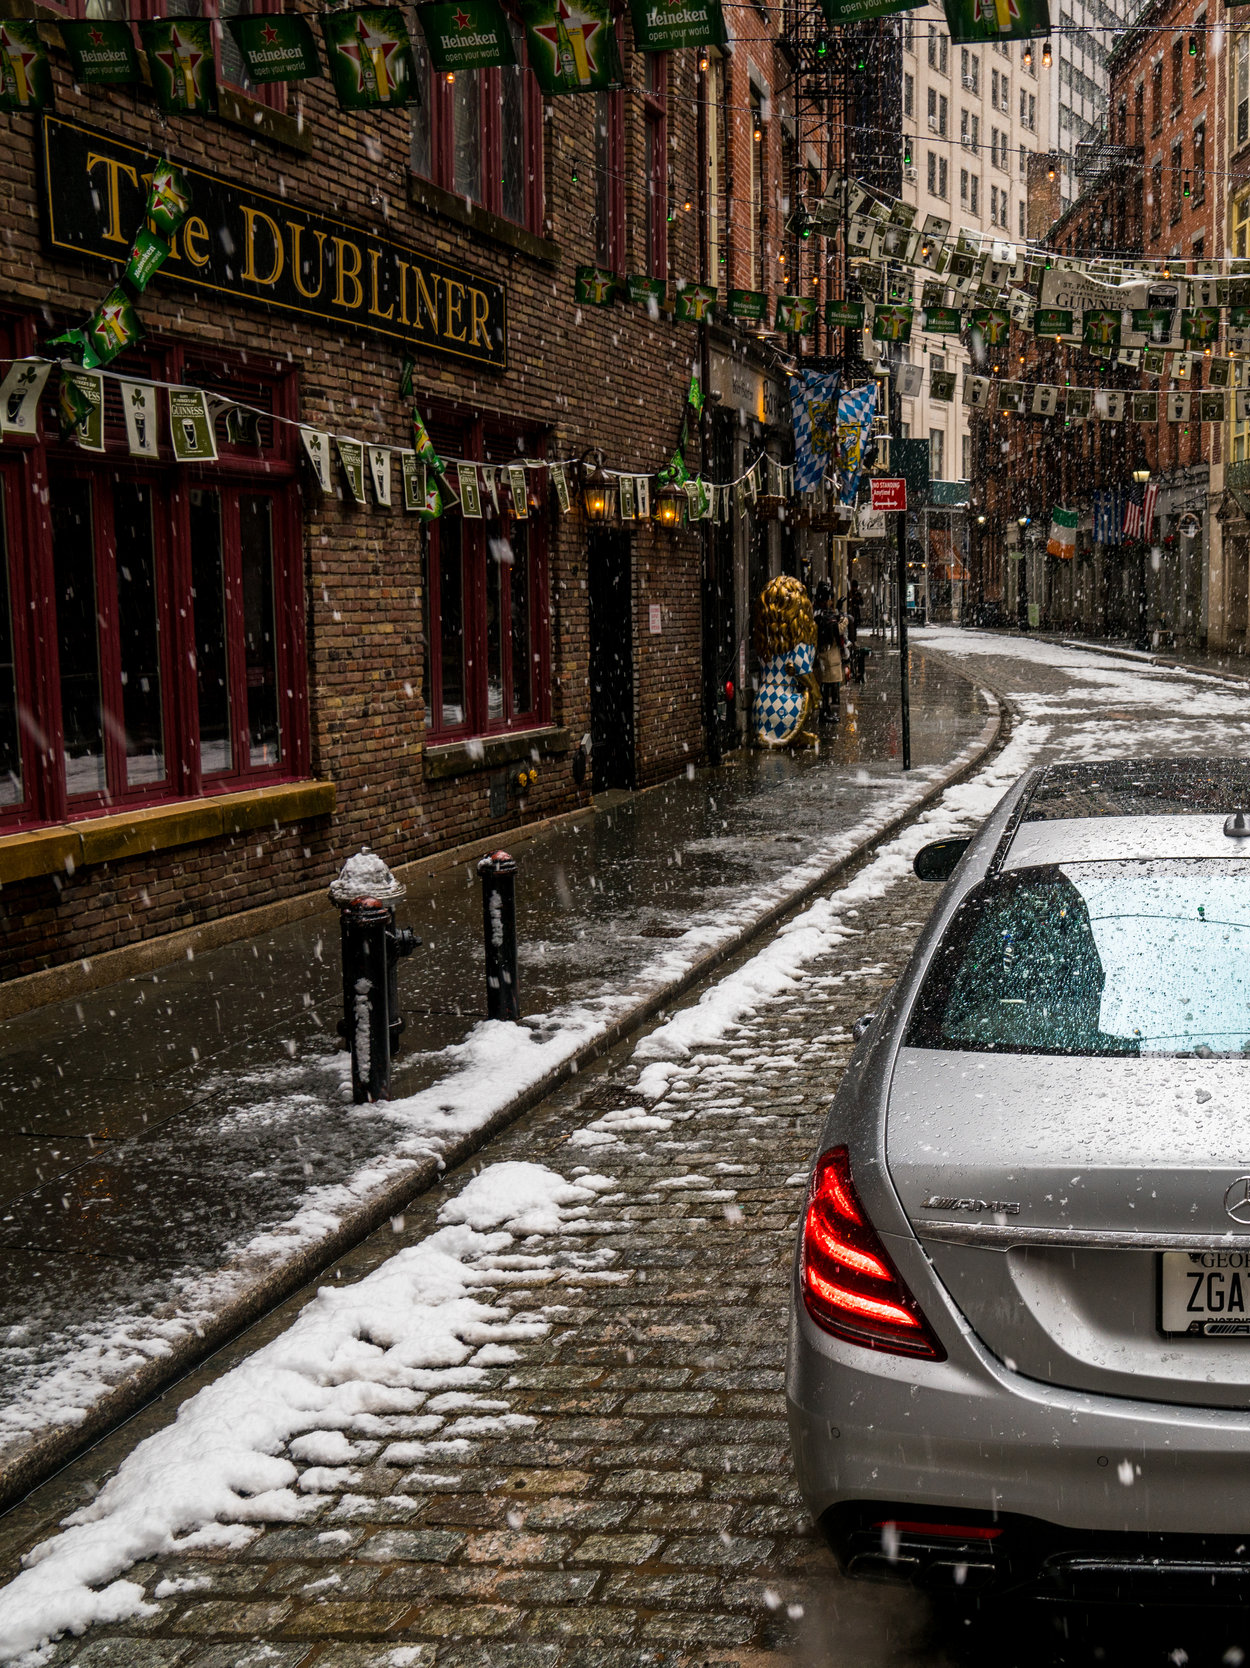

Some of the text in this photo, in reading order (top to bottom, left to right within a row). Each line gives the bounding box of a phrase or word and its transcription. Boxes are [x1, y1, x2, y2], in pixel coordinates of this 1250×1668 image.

[646, 7, 708, 28] Heineken
[840, 2, 863, 16] open
[440, 31, 498, 49] Heineken
[648, 24, 710, 42] open your world
[80, 48, 128, 63] Heineken
[248, 44, 304, 64] Heineken
[445, 47, 500, 63] open your world
[253, 66, 270, 77] open
[285, 61, 306, 72] world
[239, 205, 494, 351] DUBLINER
[1056, 292, 1134, 311] GUINNESS
[171, 404, 205, 416] GUINNESS
[879, 482, 901, 490] STANDING
